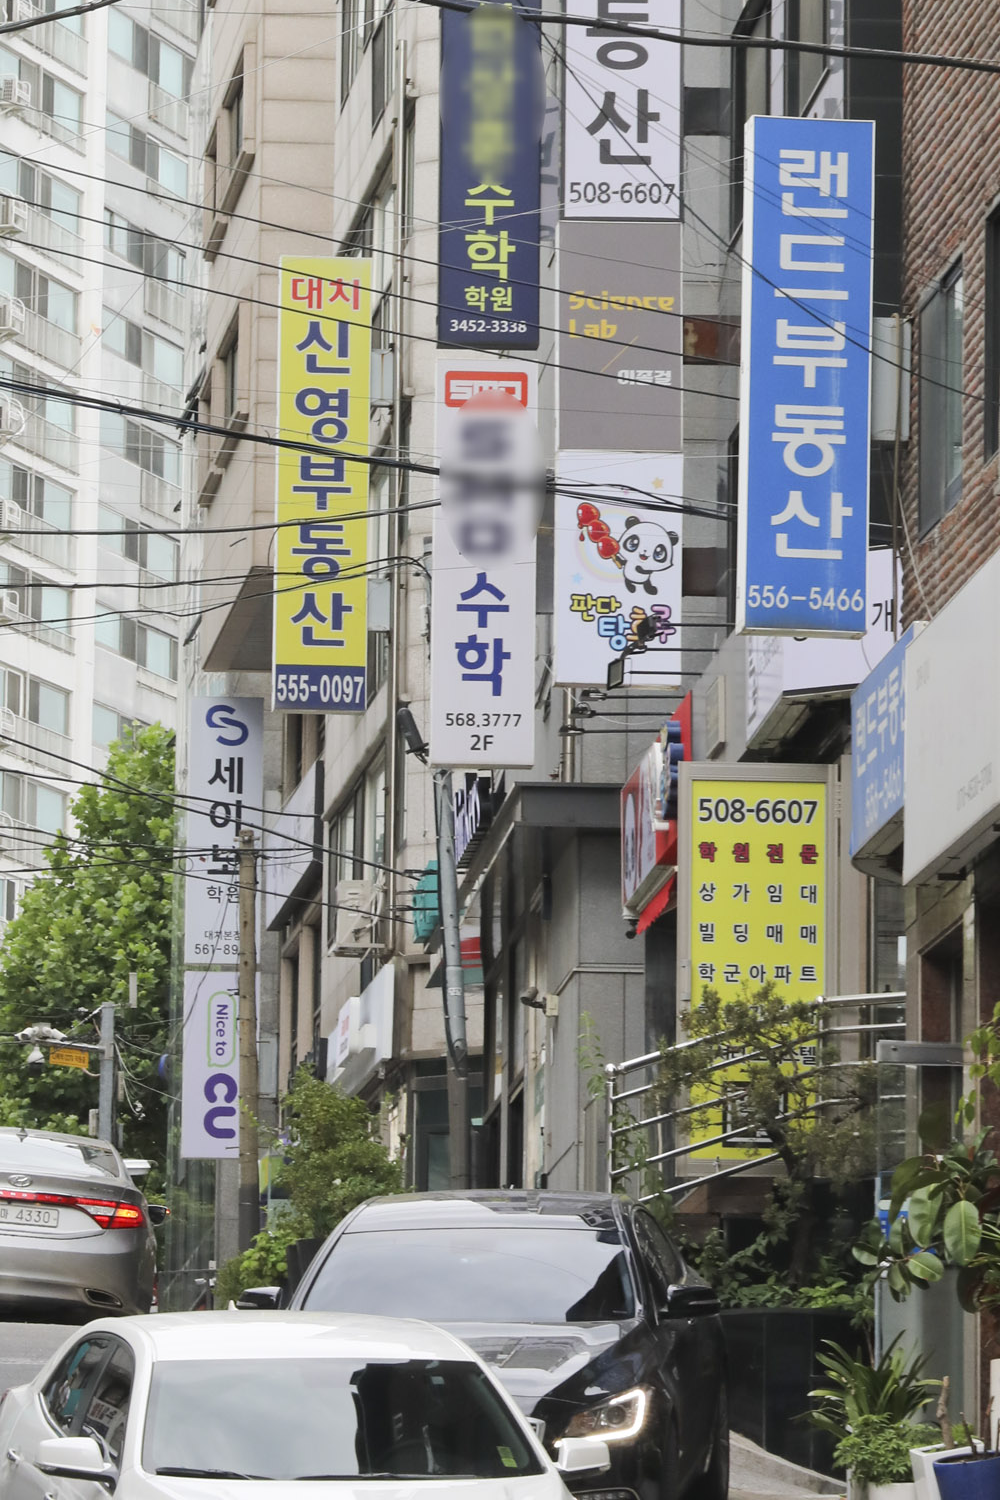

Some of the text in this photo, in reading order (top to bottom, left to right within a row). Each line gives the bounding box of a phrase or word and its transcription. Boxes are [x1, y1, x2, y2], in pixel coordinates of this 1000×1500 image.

[569, 182, 676, 205] 508-6607
[464, 176, 516, 283] 수학
[291, 277, 361, 311] 대치
[464, 286, 513, 312] 학원
[568, 290, 675, 311] Science
[450, 319, 527, 334] 3452-3338
[568, 319, 617, 339] Lab
[770, 148, 854, 560] 랜드부동산
[290, 320, 353, 647] 신영부동산
[570, 593, 622, 622] 판다
[748, 585, 864, 612] 556-5466
[455, 572, 511, 697] 수학
[277, 674, 365, 704] 555-0097
[445, 712, 522, 728] 568.3777
[470, 734, 494, 751] 2F
[698, 798, 818, 825] 508-6607
[206, 885, 240, 904] 학원
[194, 943, 238, 956] 561-89
[698, 964, 818, 985] 학군아파트
[215, 1003, 231, 1057] Nice to
[203, 1073, 238, 1139] CU
[16, 1209, 51, 1223] 4330
